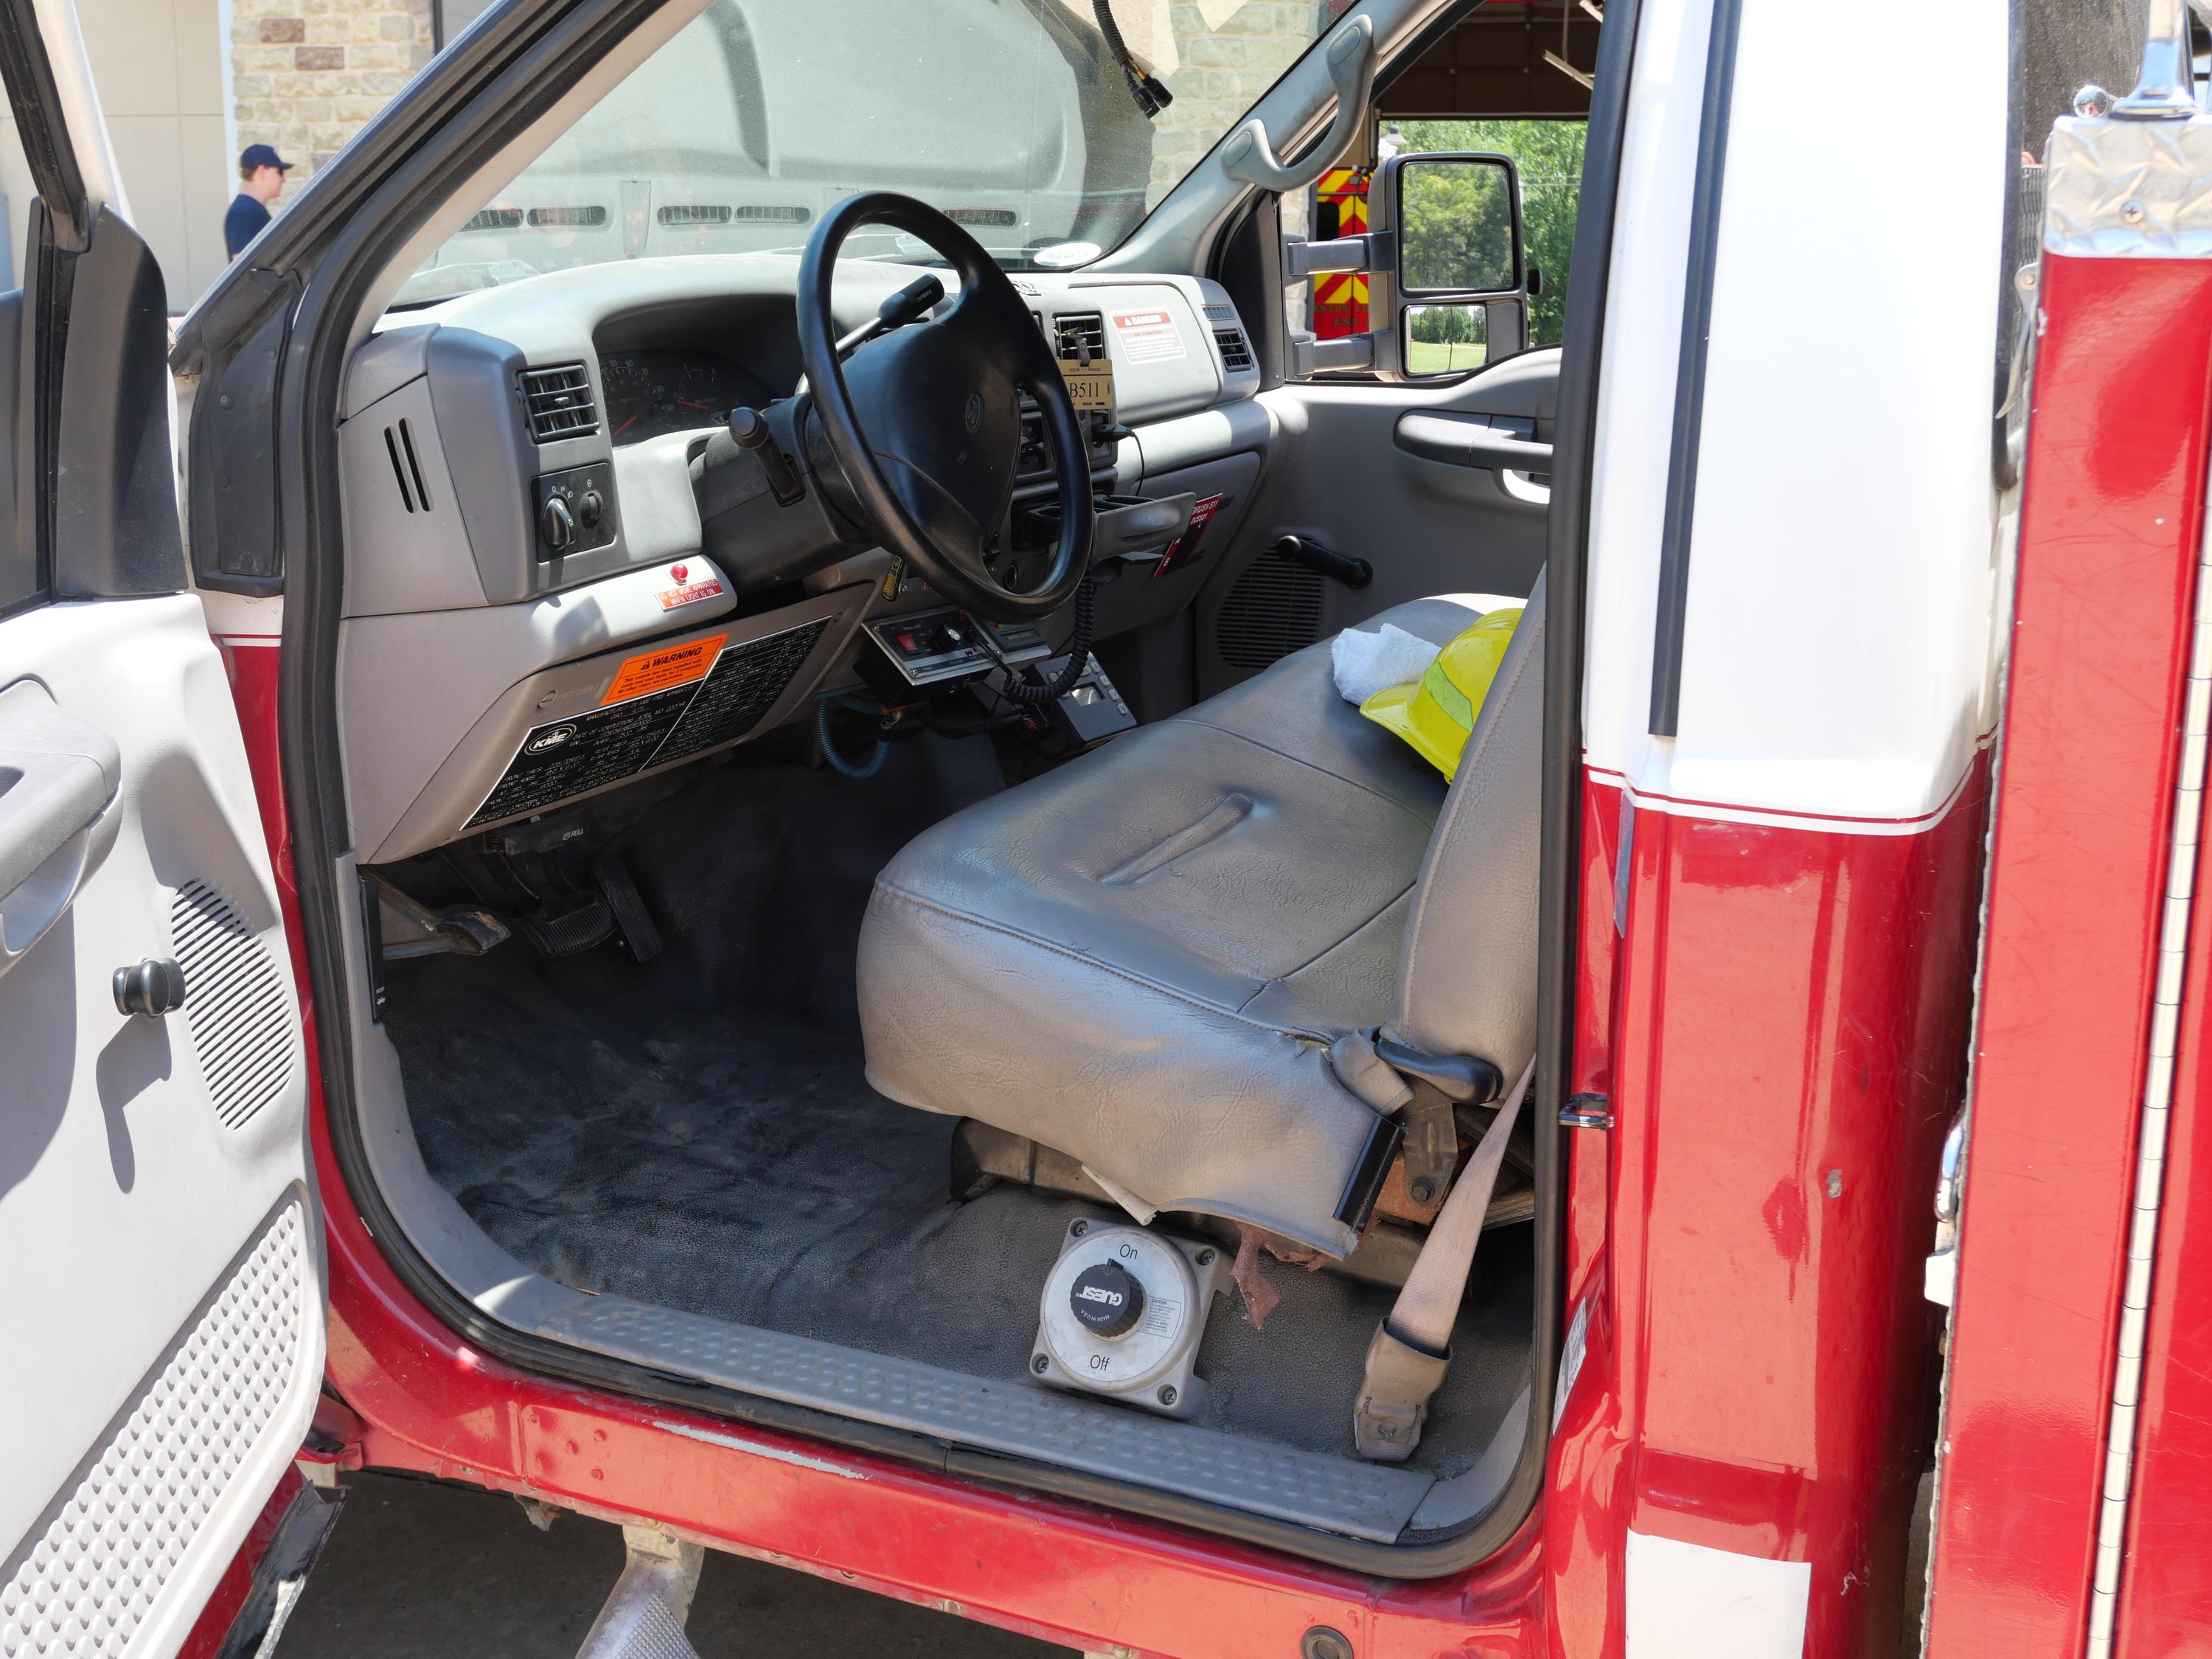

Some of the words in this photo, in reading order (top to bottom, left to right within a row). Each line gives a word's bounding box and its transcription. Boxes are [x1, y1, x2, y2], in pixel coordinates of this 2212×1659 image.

[1131, 314, 1162, 325] DANGER
[1069, 382, 1099, 397] B511
[1208, 499, 1219, 509] 511
[706, 588, 715, 596] ON
[653, 647, 702, 666] WARNING
[532, 733, 567, 750] KME
[570, 827, 584, 838] PULL
[1119, 1244, 1138, 1260] On
[1079, 1286, 1122, 1307] GUEST
[1090, 1354, 1110, 1371] Off
